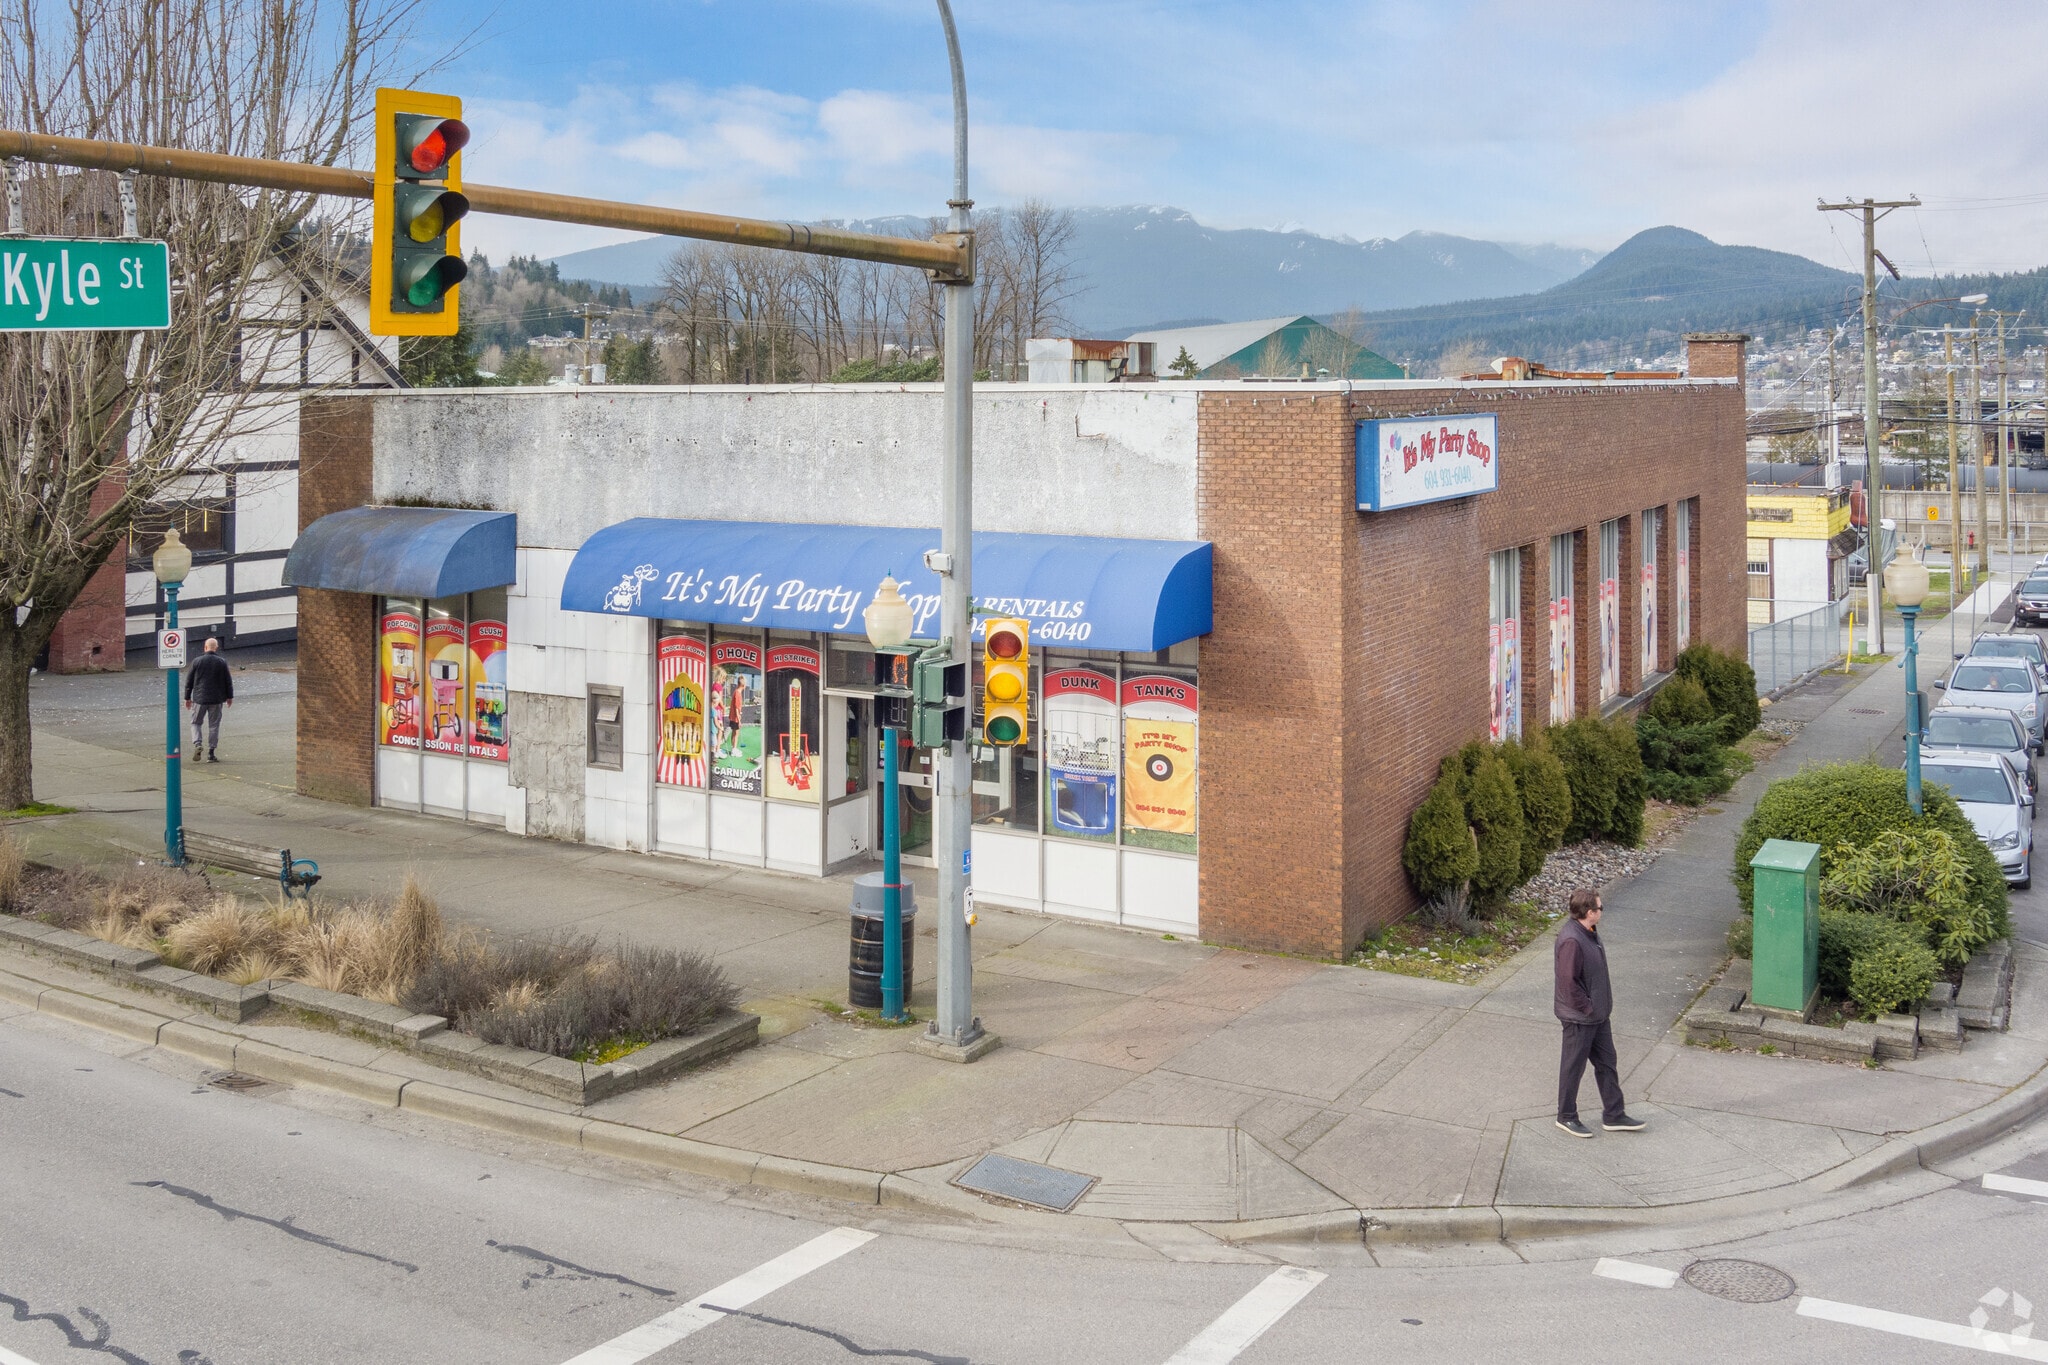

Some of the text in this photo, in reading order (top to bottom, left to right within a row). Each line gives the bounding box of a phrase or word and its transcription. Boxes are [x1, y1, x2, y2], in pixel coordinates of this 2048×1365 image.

[3, 249, 144, 321] Kyle St
[1403, 426, 1490, 474] It's My Party Shop
[1424, 465, 1472, 489] 604 931-6040
[661, 568, 713, 603] It's
[714, 572, 769, 623] My
[772, 579, 862, 630] Party
[983, 597, 1085, 619] RENTALS
[387, 620, 418, 631] POPCORN
[426, 624, 446, 634] CANDY
[479, 627, 503, 637] SLUSH
[662, 644, 680, 654] KNOCK
[686, 645, 706, 657] CLOWN
[717, 648, 757, 662] 9 HOLE
[784, 654, 817, 666] STRIKER
[1061, 677, 1185, 699] DUNK TANKS
[392, 734, 499, 757] CONCESSION RENTALS
[1134, 740, 1188, 753] PARTY SHOP
[714, 766, 761, 780] CARNIVAL
[721, 779, 754, 791] GAMES
